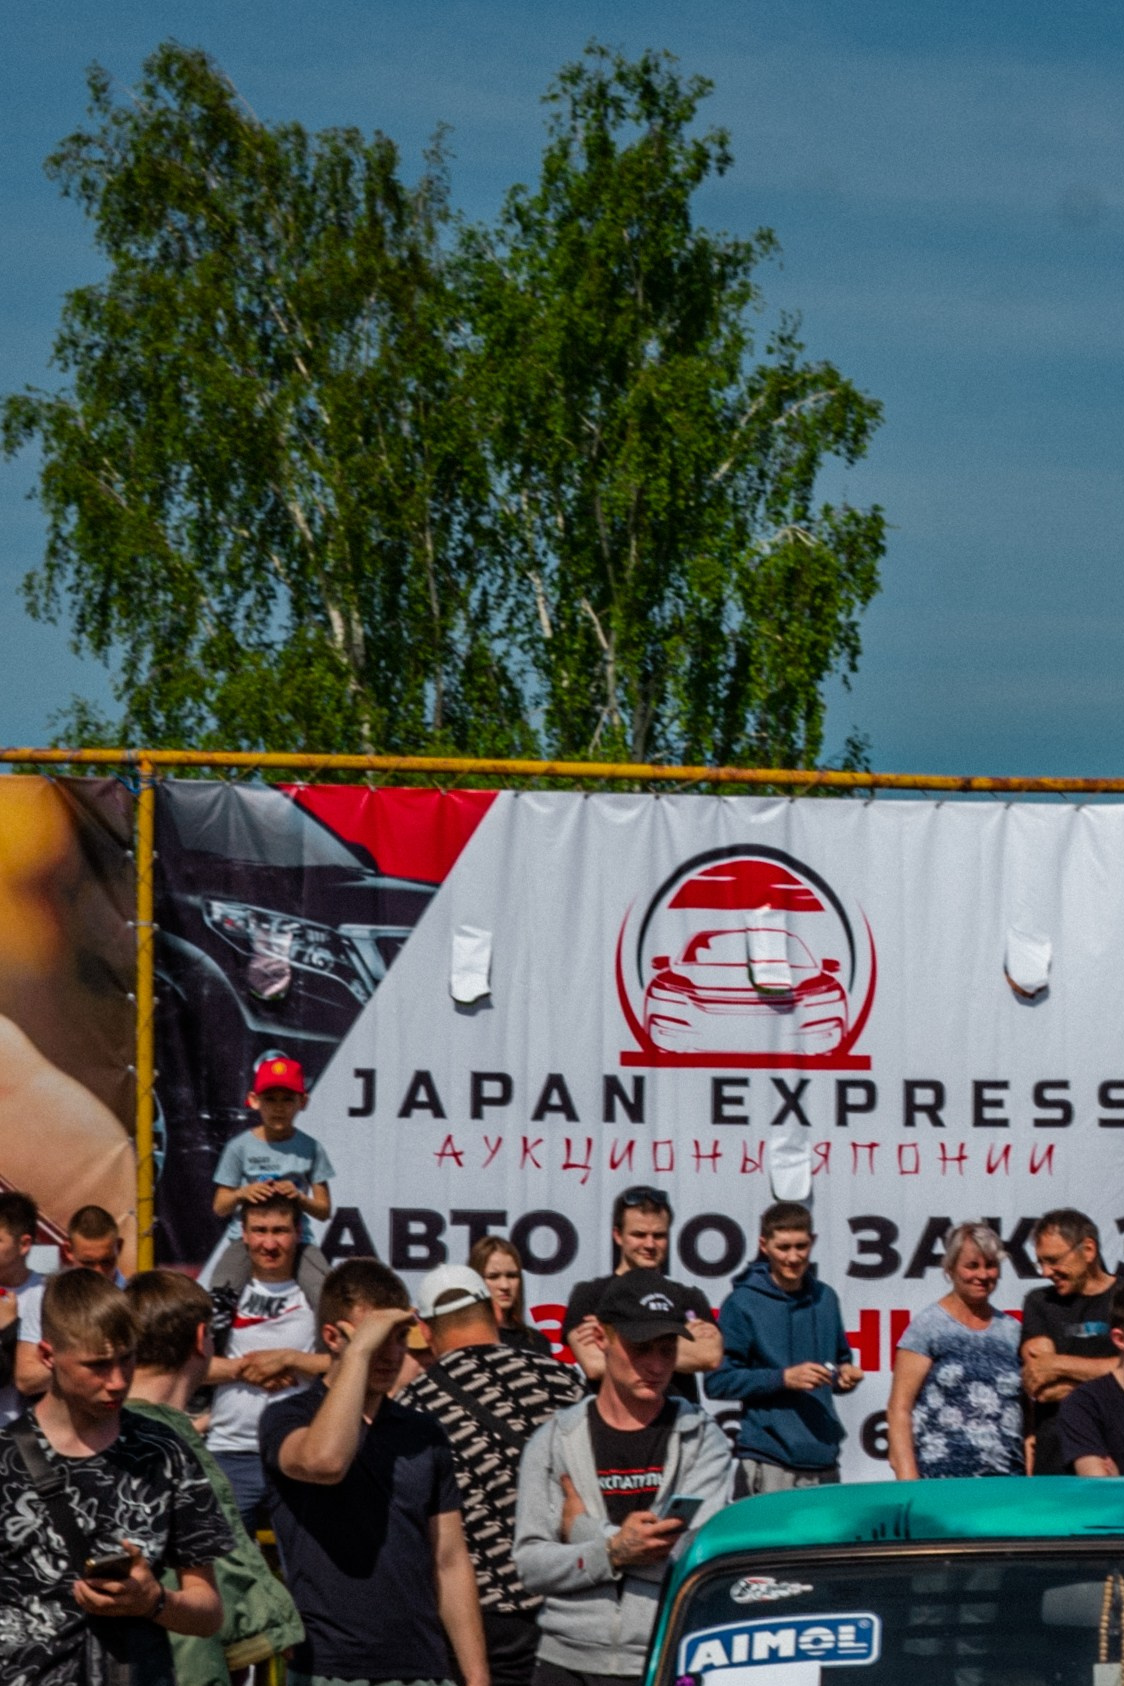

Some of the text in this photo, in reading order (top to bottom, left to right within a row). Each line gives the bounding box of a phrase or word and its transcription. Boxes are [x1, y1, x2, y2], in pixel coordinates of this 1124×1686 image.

[348, 1068, 645, 1124] JAPAN
[433, 1134, 1056, 1185] АУКЦИОНЫ ЯПОНИИ
